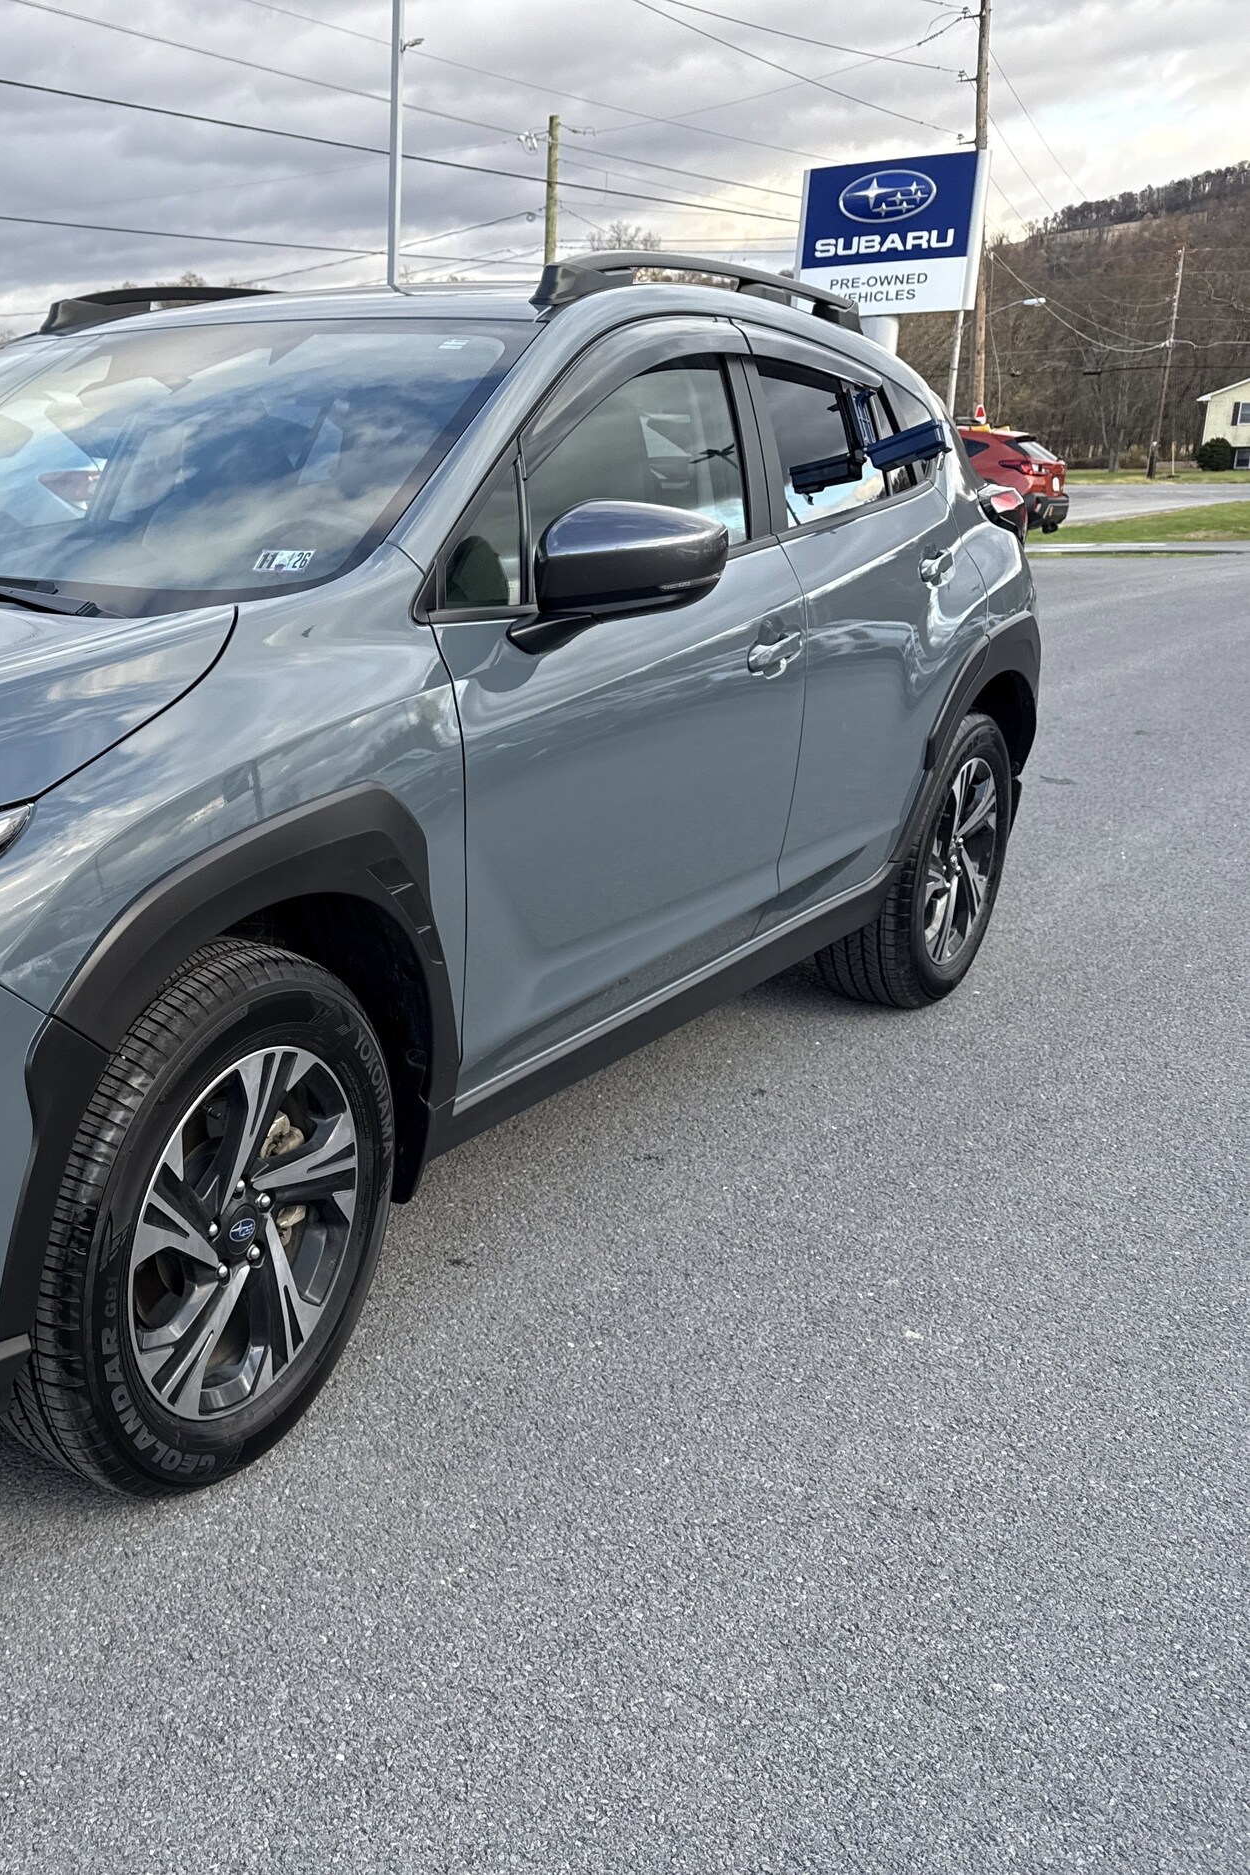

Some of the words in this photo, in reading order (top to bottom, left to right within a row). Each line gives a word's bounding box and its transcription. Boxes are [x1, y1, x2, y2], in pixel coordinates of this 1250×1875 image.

[814, 228, 955, 258] SUBARU
[829, 272, 928, 290] PRE-OWNED
[258, 551, 280, 569] 11
[291, 551, 312, 569] 26
[353, 1027, 393, 1160] YOKOHAMA
[101, 1326, 216, 1475] GEOLANDAR
